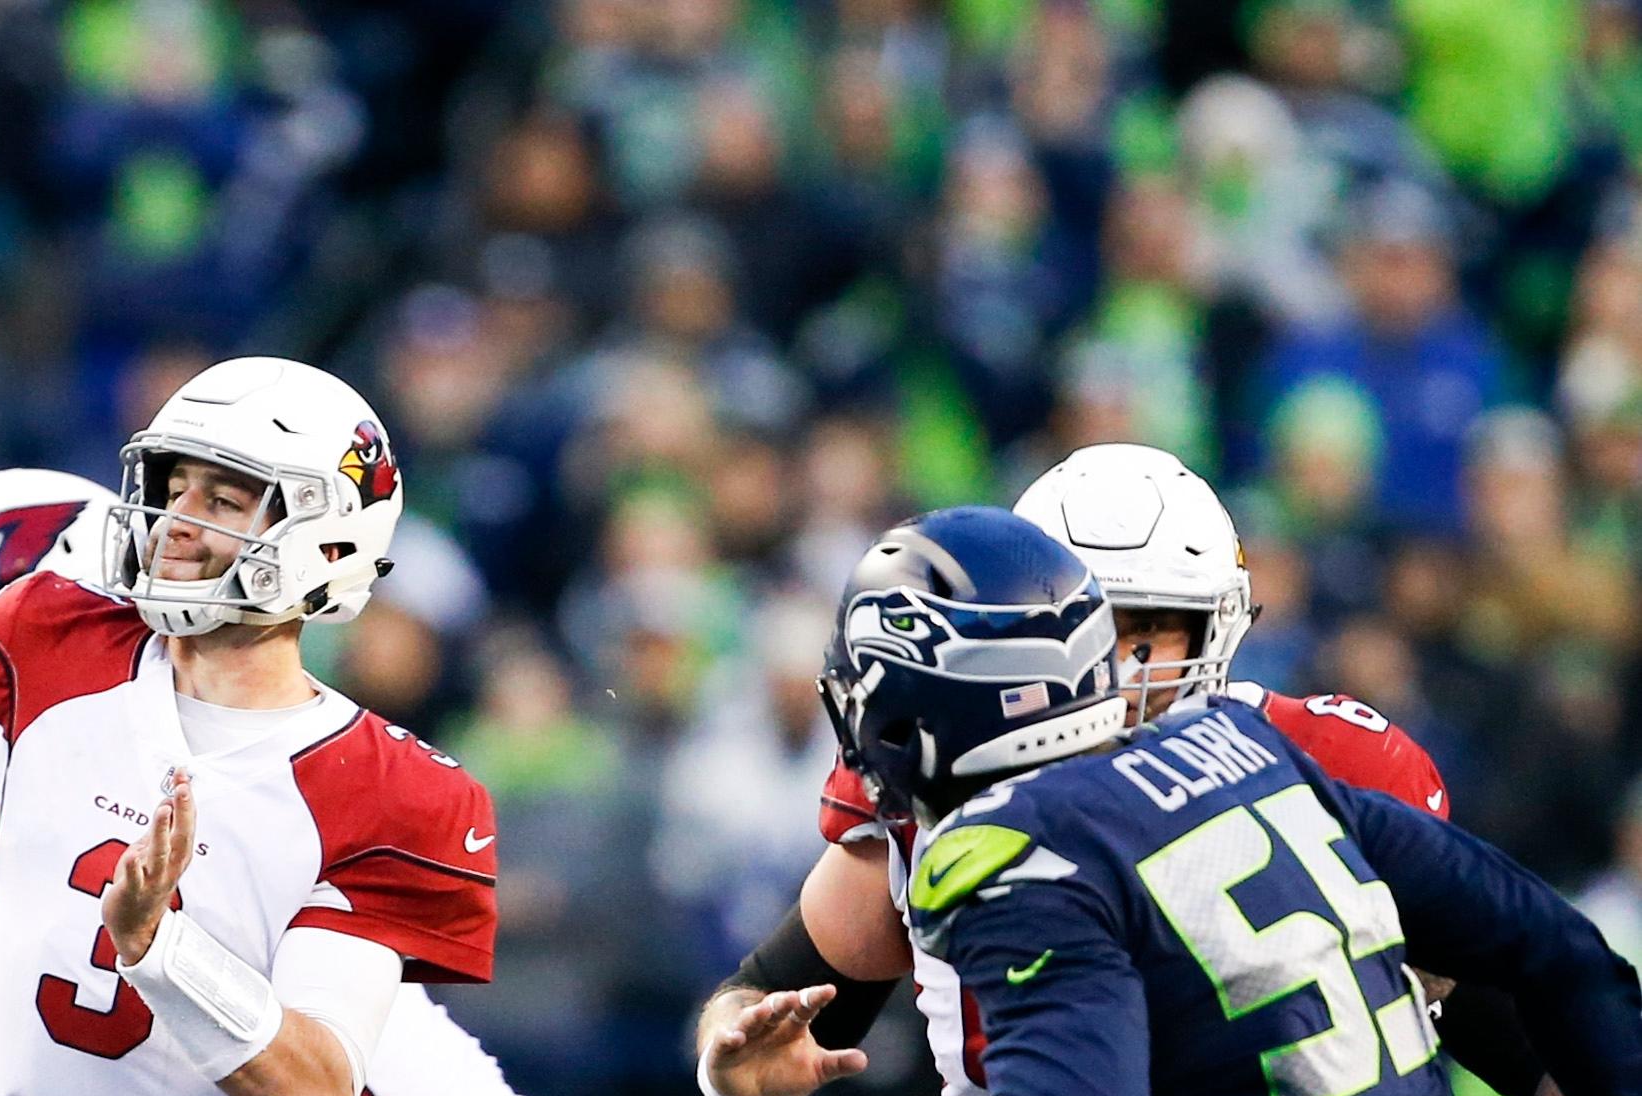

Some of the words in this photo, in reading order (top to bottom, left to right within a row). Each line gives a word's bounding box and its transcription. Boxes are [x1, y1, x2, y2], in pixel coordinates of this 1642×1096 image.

[1111, 711, 1278, 813] CLARK
[94, 794, 210, 857] CARDS
[35, 838, 184, 1060] 3
